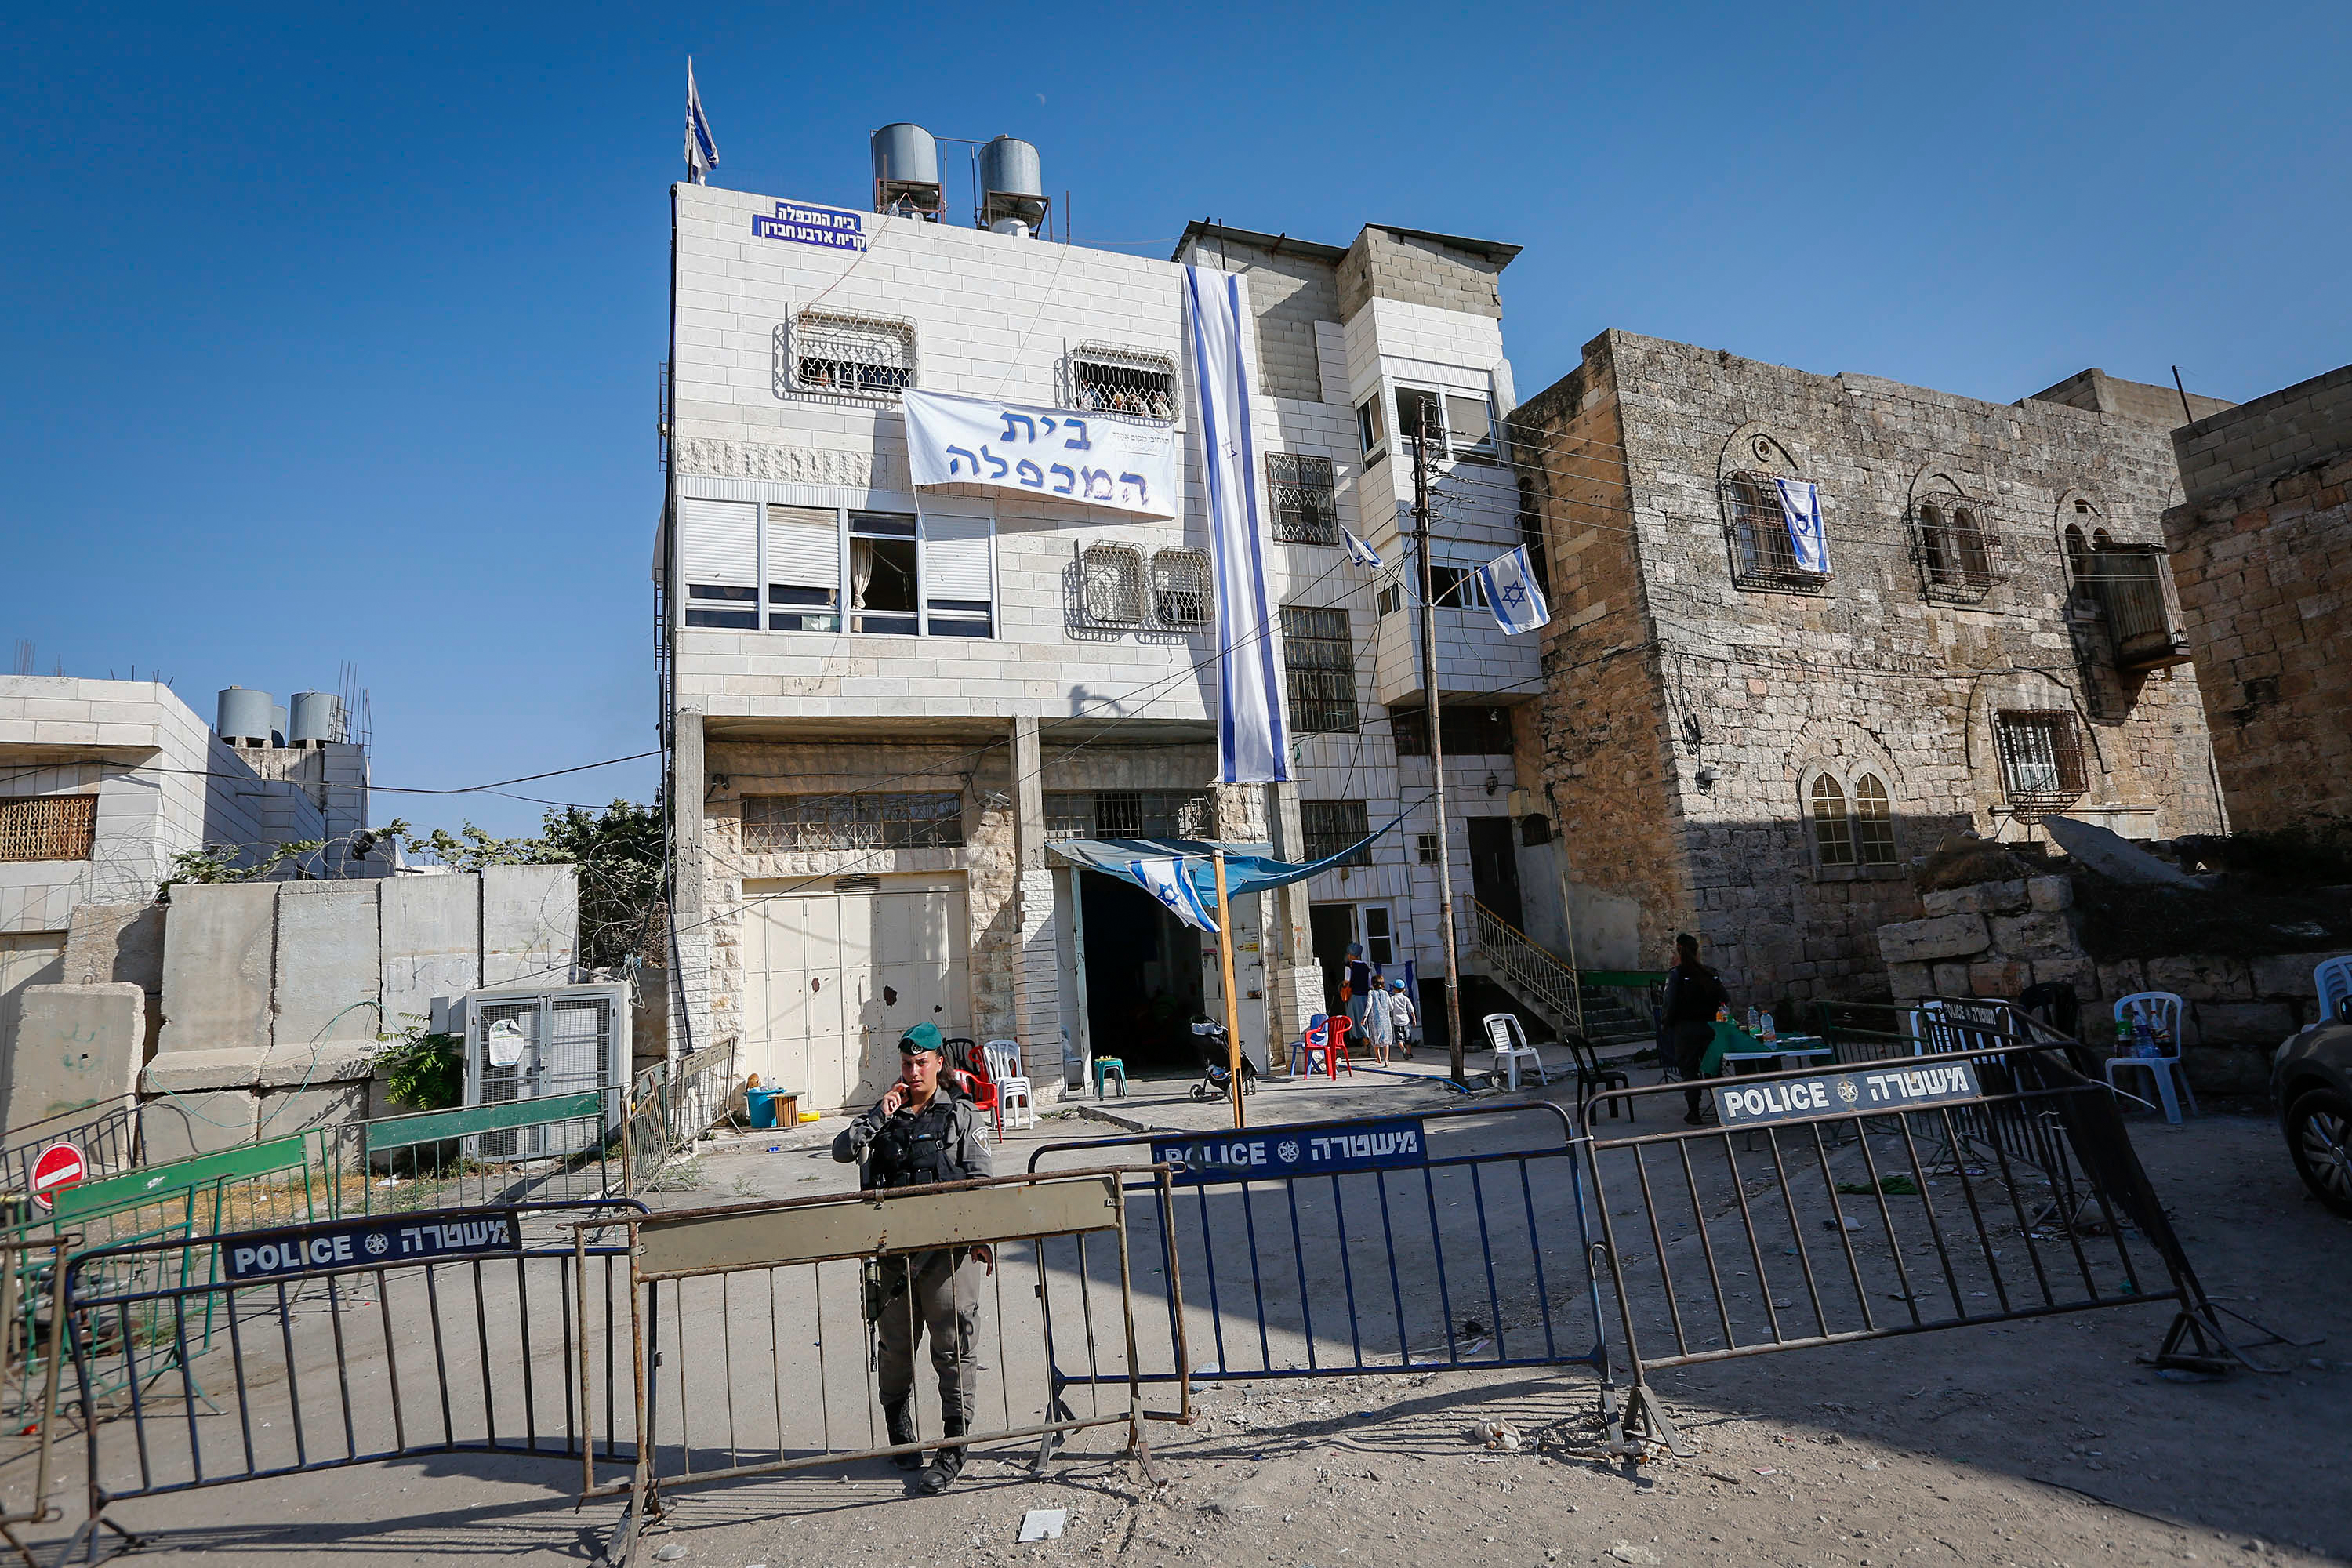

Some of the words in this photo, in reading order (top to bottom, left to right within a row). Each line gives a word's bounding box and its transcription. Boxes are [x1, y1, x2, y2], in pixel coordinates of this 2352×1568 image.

[760, 220, 796, 238] חברון
[778, 206, 831, 226] המכפלה
[797, 228, 833, 245] ארבע
[836, 232, 866, 252] קרית
[1000, 411, 1091, 450] בית
[946, 445, 1149, 506] המכפלה
[1724, 1082, 1830, 1117] POLICE
[1867, 1066, 1969, 1101] משטרה
[1165, 1142, 1267, 1171] POLICE
[1310, 1131, 1417, 1161] משטרה
[401, 1219, 510, 1253] משטרה
[235, 1235, 354, 1274] POLICE
